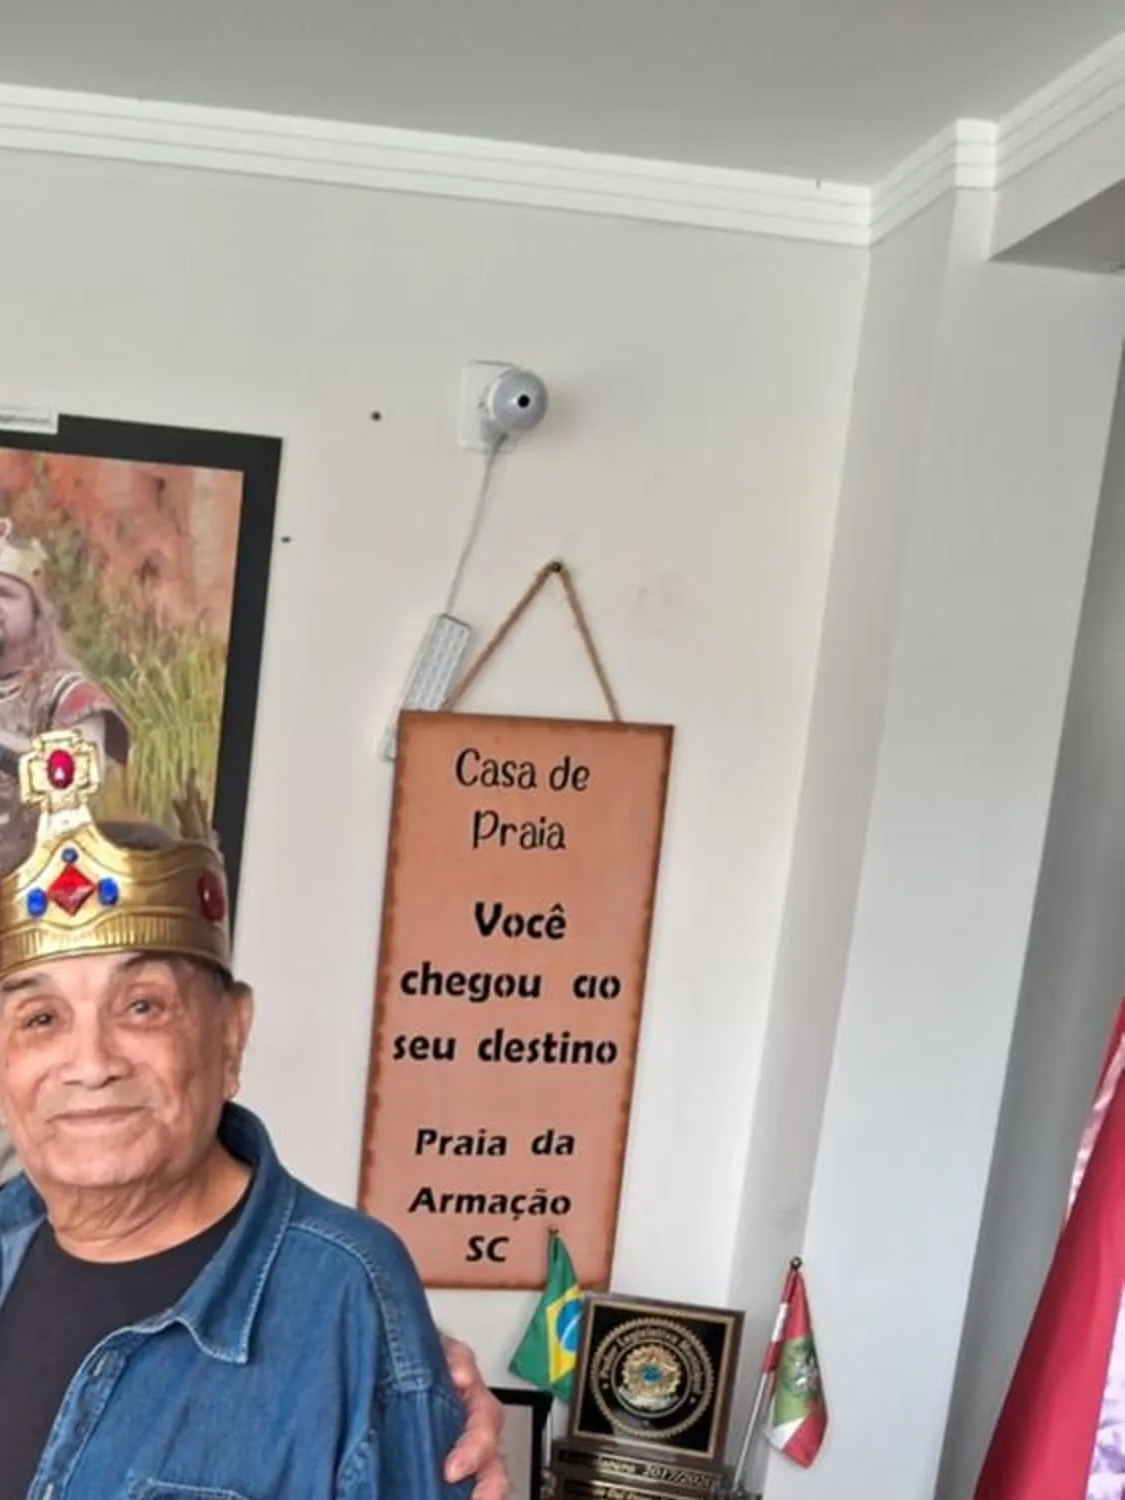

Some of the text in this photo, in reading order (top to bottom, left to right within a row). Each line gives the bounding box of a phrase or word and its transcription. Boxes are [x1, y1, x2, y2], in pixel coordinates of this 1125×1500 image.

[455, 748, 590, 792] Casa de
[472, 810, 566, 850] Praia
[475, 901, 567, 940] Você
[400, 961, 621, 1003] chegou ao
[393, 1027, 618, 1065] seu destino
[415, 1128, 575, 1157] Praia da
[408, 1187, 572, 1221] Armação
[465, 1235, 510, 1263] SC
